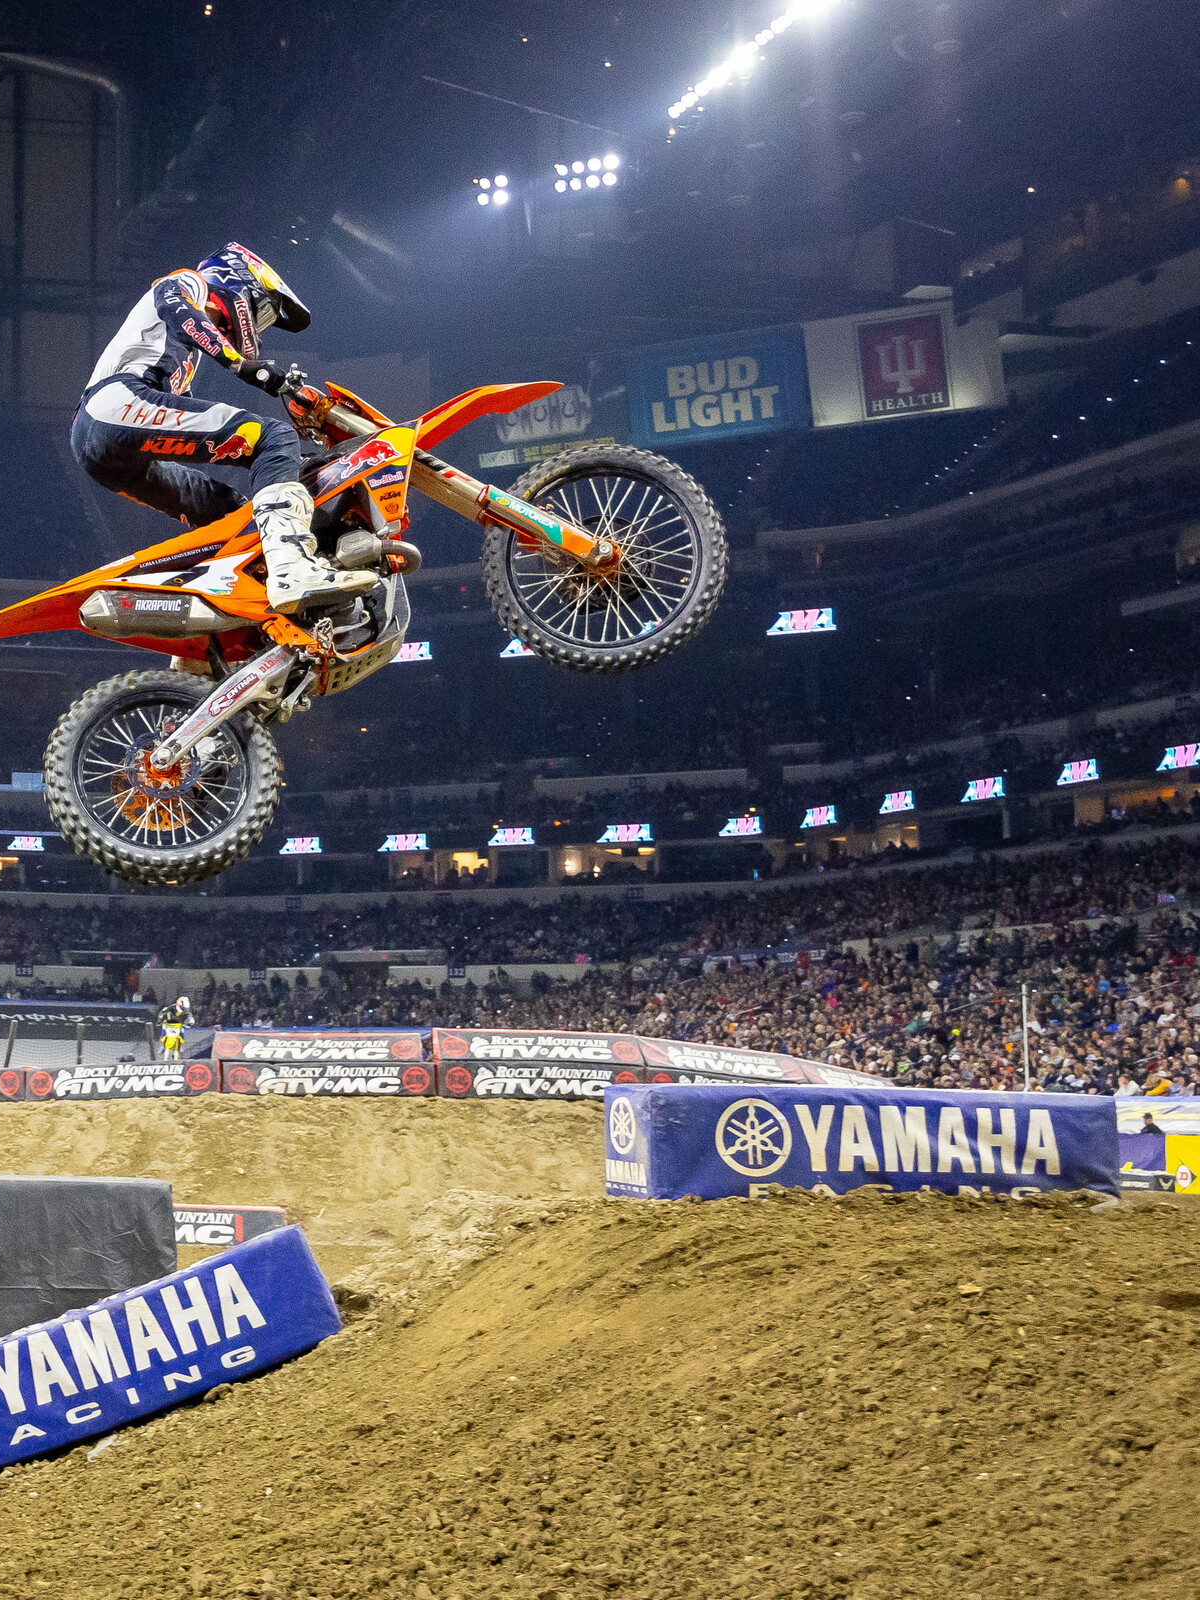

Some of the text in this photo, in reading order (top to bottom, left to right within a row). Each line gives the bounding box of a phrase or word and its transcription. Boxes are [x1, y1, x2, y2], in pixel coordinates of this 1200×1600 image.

[667, 356, 759, 398] BUD
[653, 386, 779, 432] LIGHT
[871, 391, 944, 412] HEALTH
[141, 437, 199, 455] KTM
[508, 502, 555, 528] MOTOREX
[171, 549, 201, 560] UNIVERSITY
[766, 608, 836, 635] AMA
[391, 642, 433, 661] MA
[1057, 759, 1099, 785] AMA
[961, 776, 1005, 802] AMA
[879, 790, 915, 814] AMA
[800, 805, 837, 828] AMA
[597, 823, 654, 843] AMA
[718, 816, 762, 837] AMA
[279, 837, 322, 854] AMA
[377, 833, 429, 852] AMA
[488, 827, 536, 846] AMA
[266, 1039, 389, 1048] ROCKY MOUNTAIN
[491, 1036, 608, 1048] ROCKY MOUNTAIN
[73, 1064, 185, 1078] ROCKY MOUNTAIN
[279, 1066, 400, 1077] ROCKY MOUNTAIN
[496, 1066, 613, 1080] ROCKY MOUNTAIN
[794, 1105, 1061, 1175] YAMAHA
[173, 1211, 234, 1224] UNTAIN
